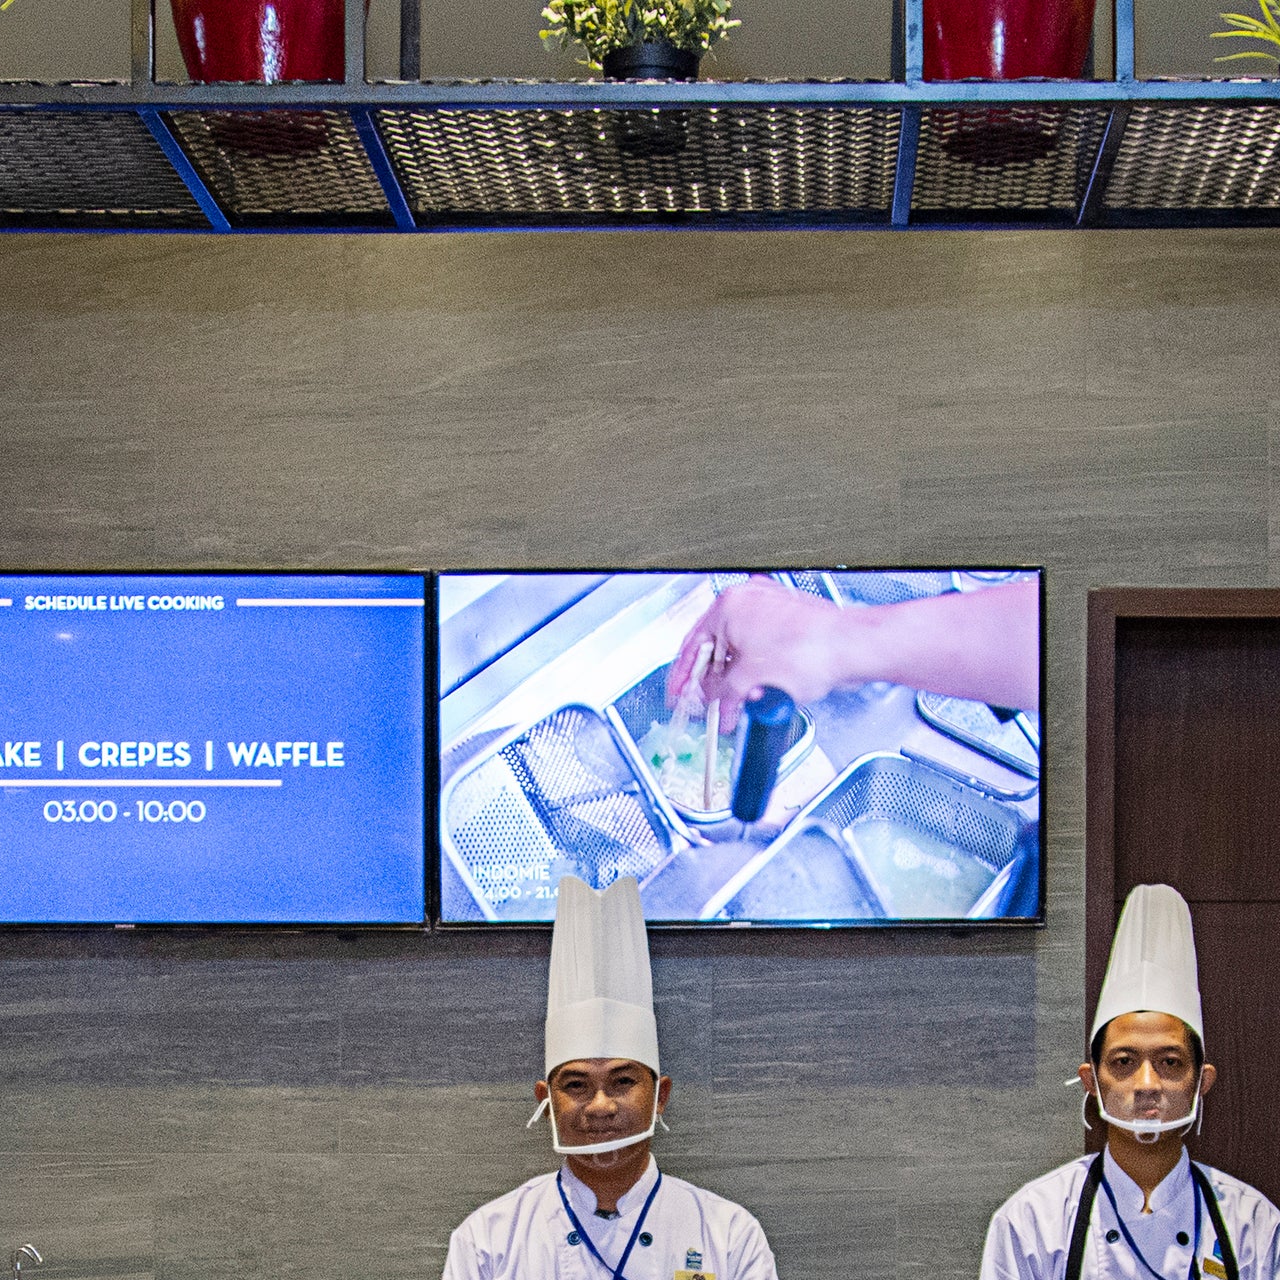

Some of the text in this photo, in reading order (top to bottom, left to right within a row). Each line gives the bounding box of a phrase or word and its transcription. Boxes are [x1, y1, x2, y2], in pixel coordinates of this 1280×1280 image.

[24, 595, 225, 611] SCHEDULE LIVE COOKING
[78, 741, 191, 768] CREPES
[227, 741, 345, 768] WAFFLE
[43, 800, 118, 823] 03.00
[136, 800, 206, 823] 10:00
[473, 865, 551, 880] INDOMIE
